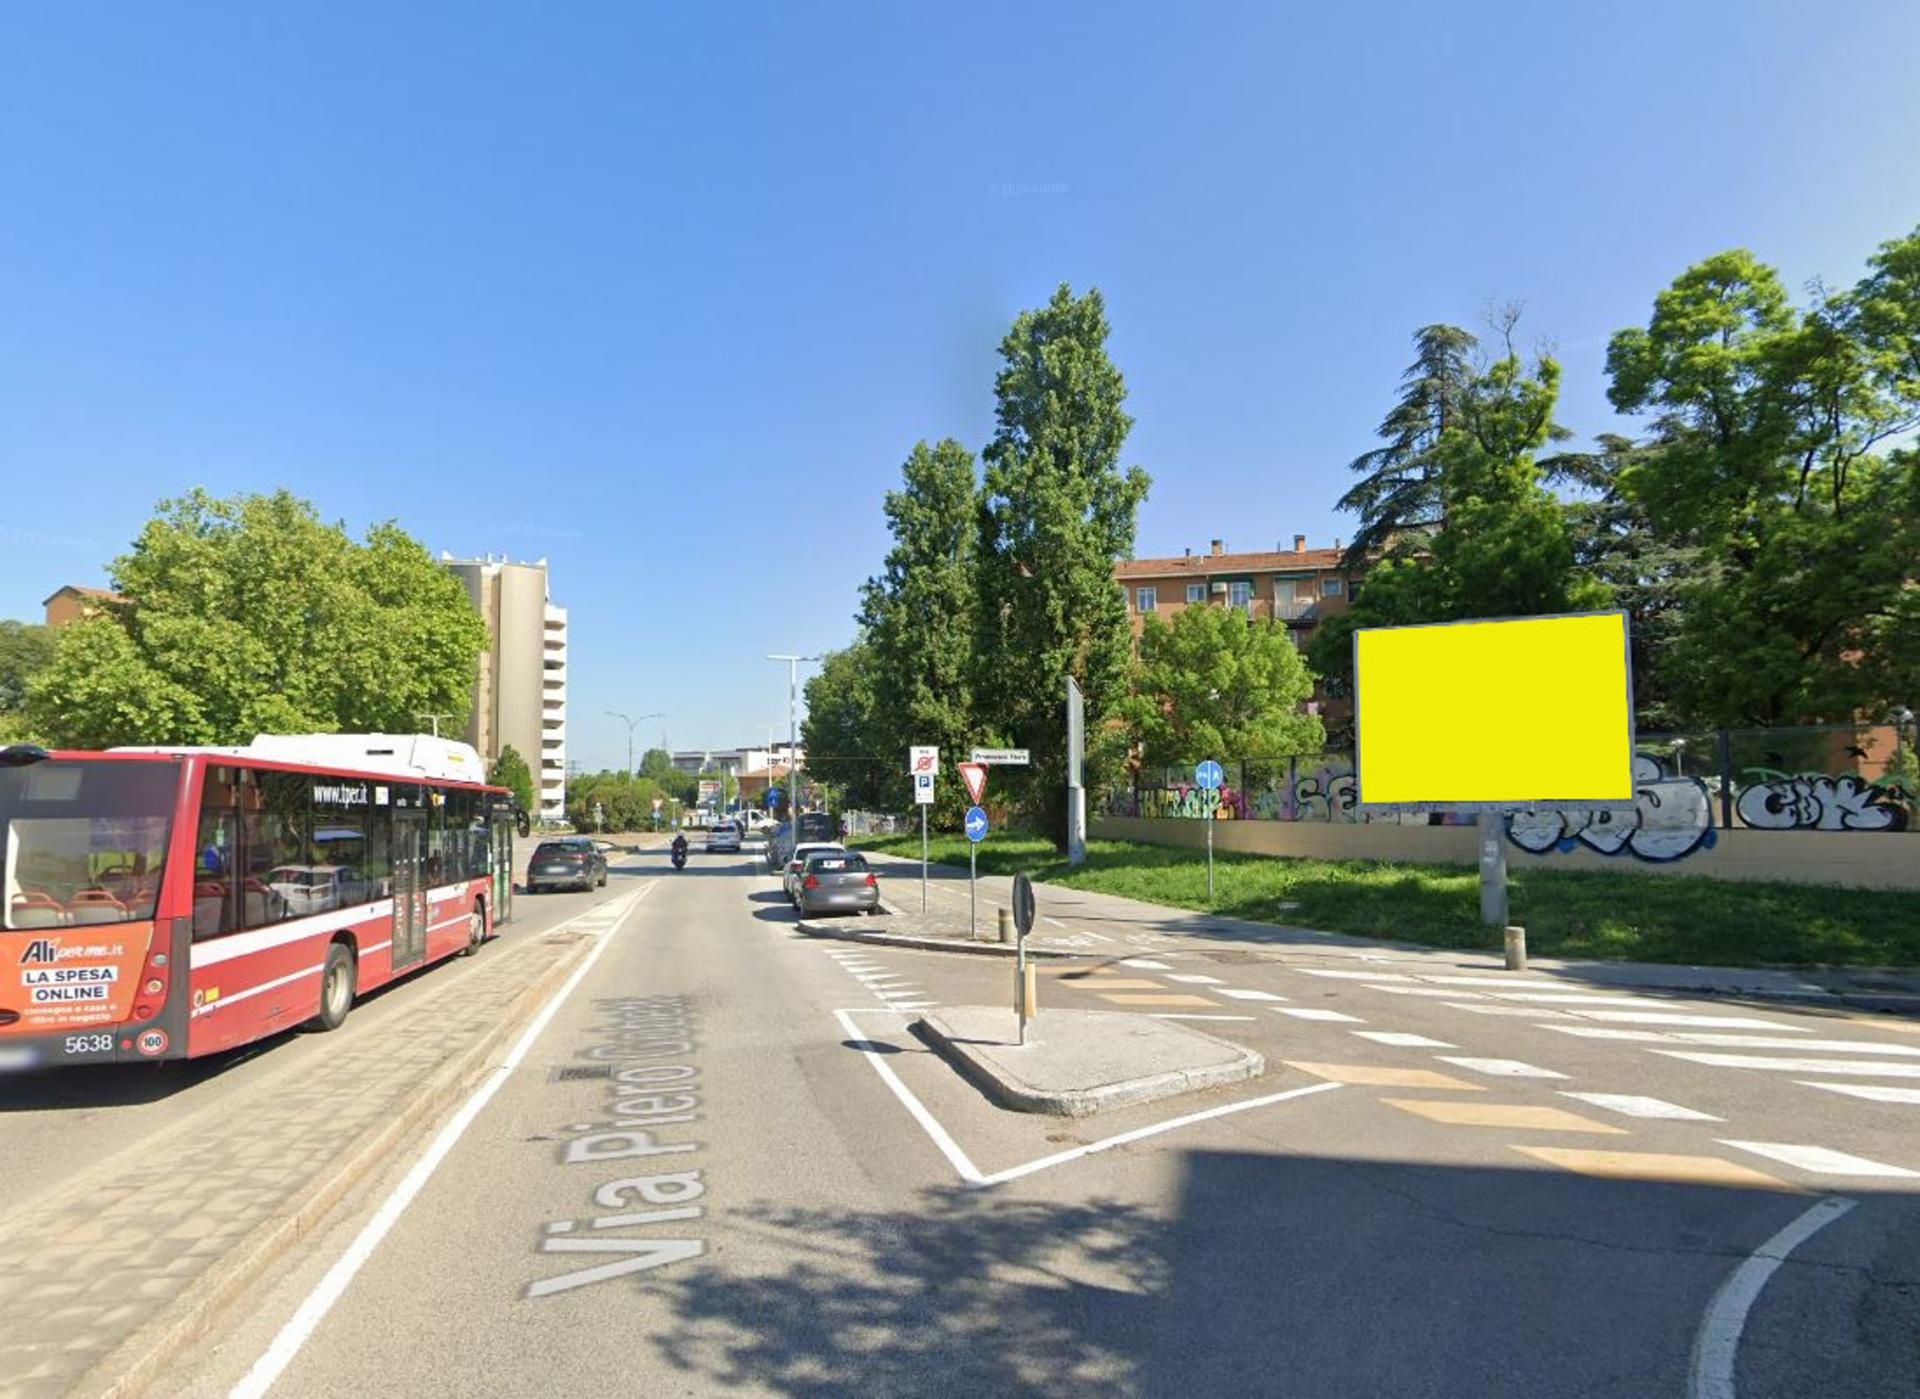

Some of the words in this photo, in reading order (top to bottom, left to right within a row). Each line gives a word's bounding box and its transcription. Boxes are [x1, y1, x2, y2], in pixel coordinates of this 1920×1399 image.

[26, 971, 50, 984] LA
[55, 968, 113, 982] SPESA
[35, 986, 105, 1001] ONLINE
[64, 1034, 113, 1054] 5638
[142, 1035, 162, 1048] 100
